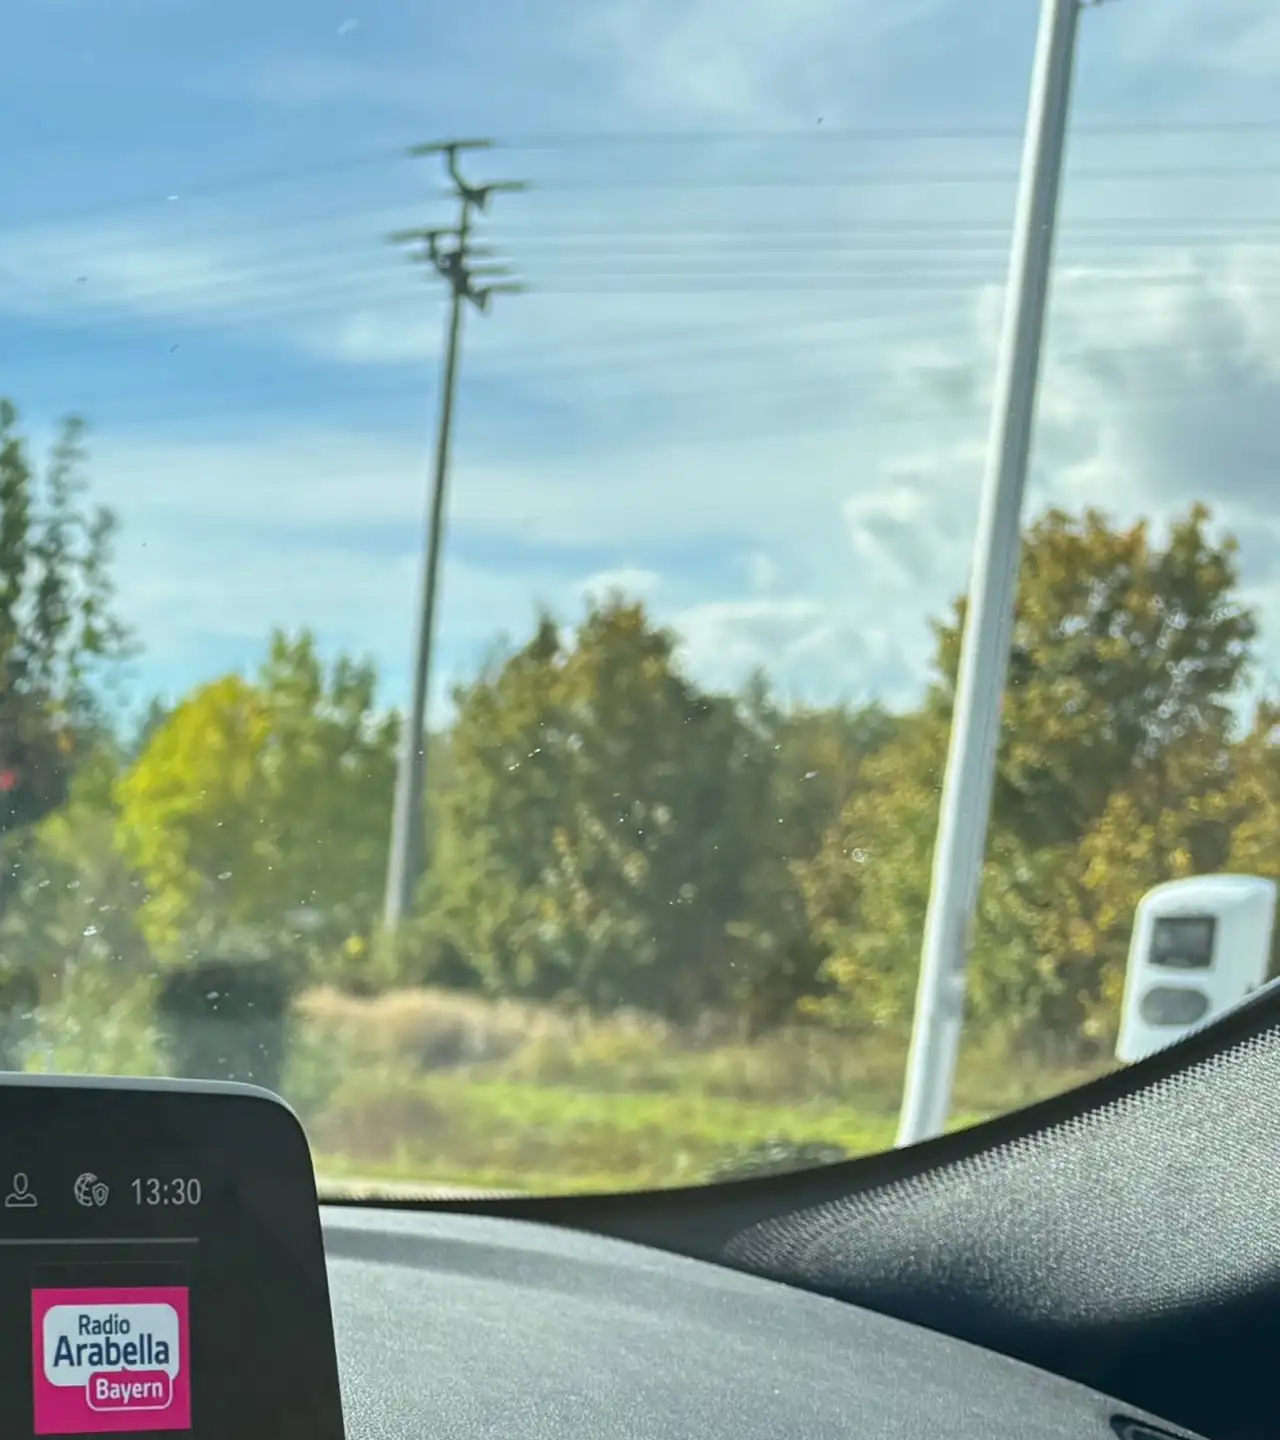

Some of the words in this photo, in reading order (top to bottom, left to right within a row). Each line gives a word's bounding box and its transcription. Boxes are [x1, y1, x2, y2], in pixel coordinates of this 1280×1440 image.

[130, 1178, 202, 1206] 13:30
[78, 1313, 131, 1336] Radio
[53, 1334, 170, 1369] Arabella
[95, 1376, 164, 1402] Bayern
